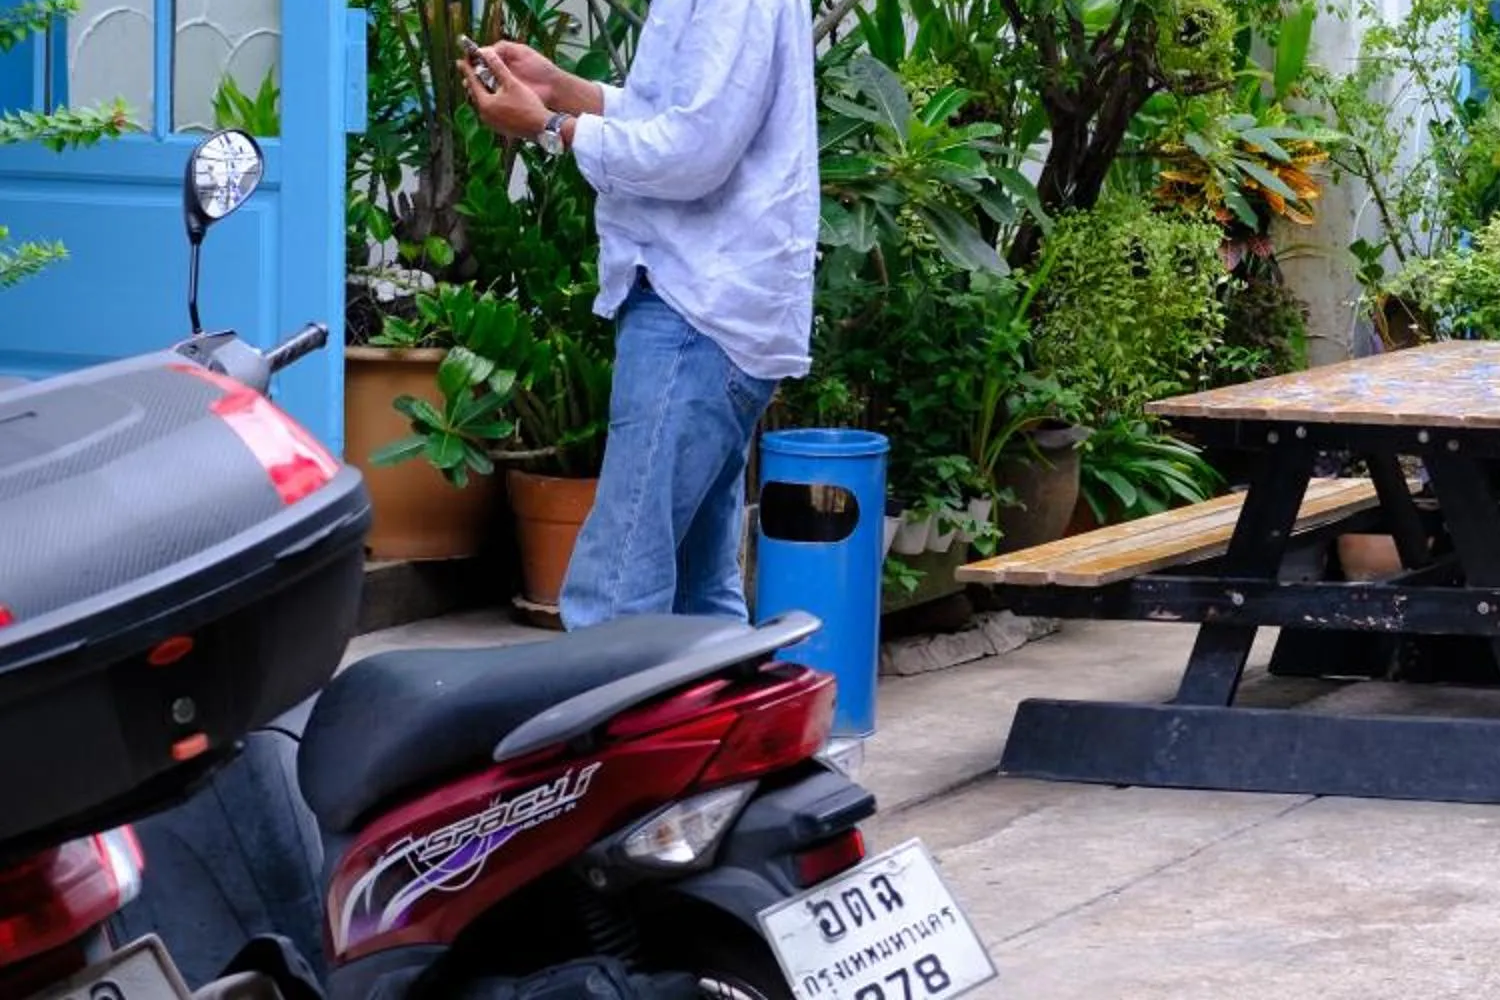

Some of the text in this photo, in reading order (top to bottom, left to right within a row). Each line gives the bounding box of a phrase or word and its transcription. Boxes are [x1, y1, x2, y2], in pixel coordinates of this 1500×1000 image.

[802, 905, 956, 997] กรุงเทพมหานคร
